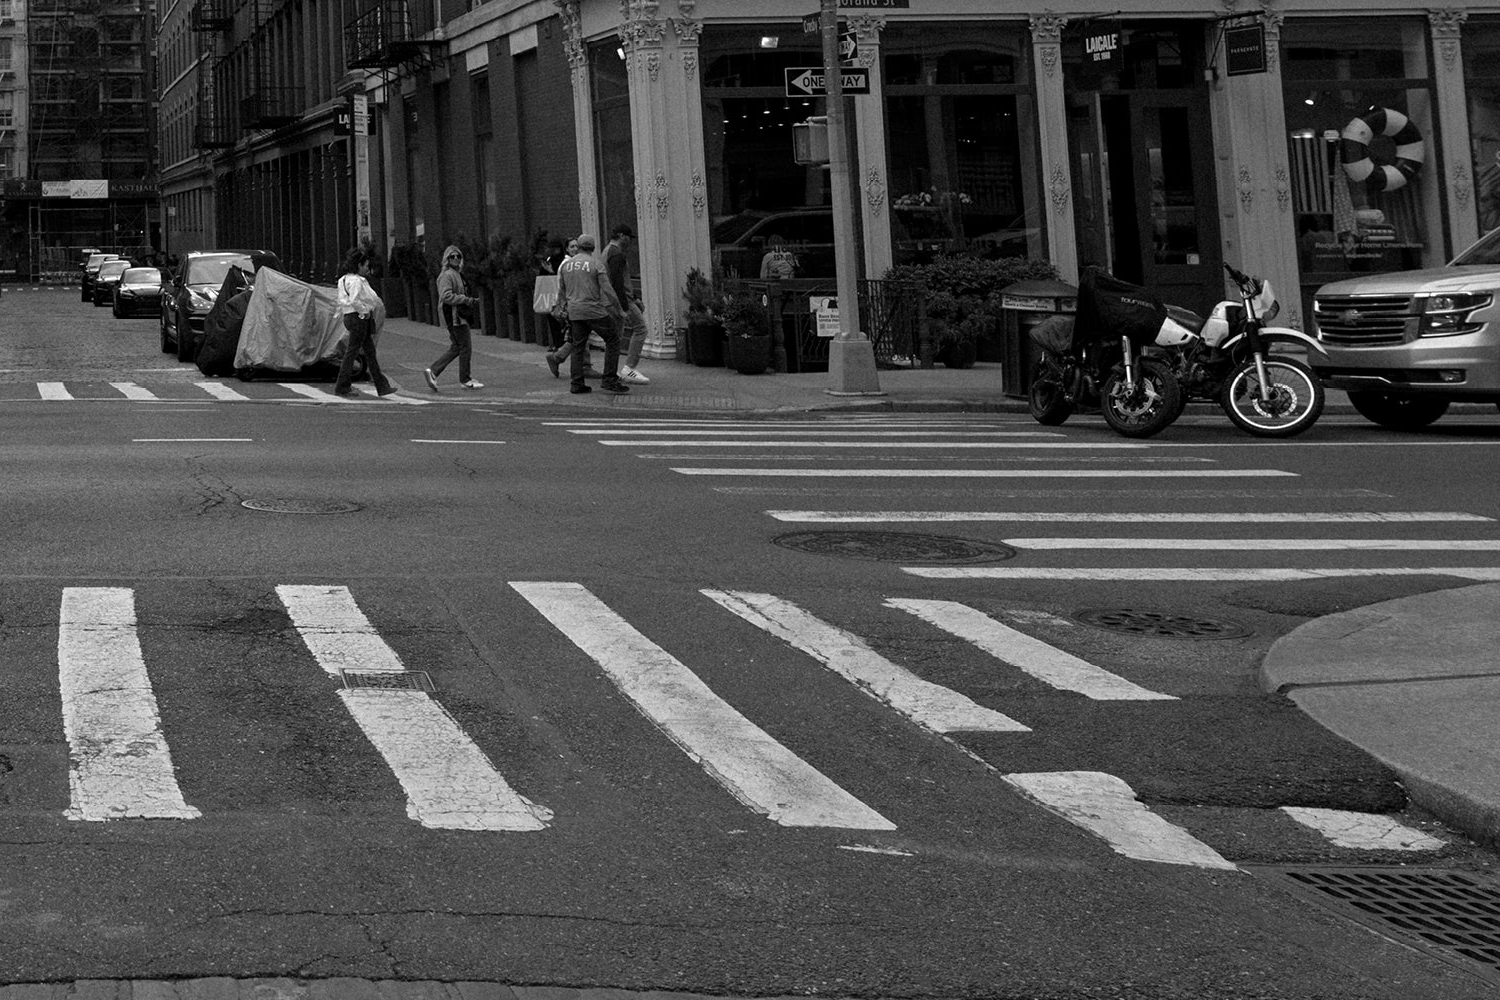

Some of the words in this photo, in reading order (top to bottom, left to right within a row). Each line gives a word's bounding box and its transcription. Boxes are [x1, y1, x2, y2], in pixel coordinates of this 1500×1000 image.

[1085, 33, 1118, 54] LAICALE
[802, 76, 825, 88] ONE
[566, 261, 591, 272] USA
